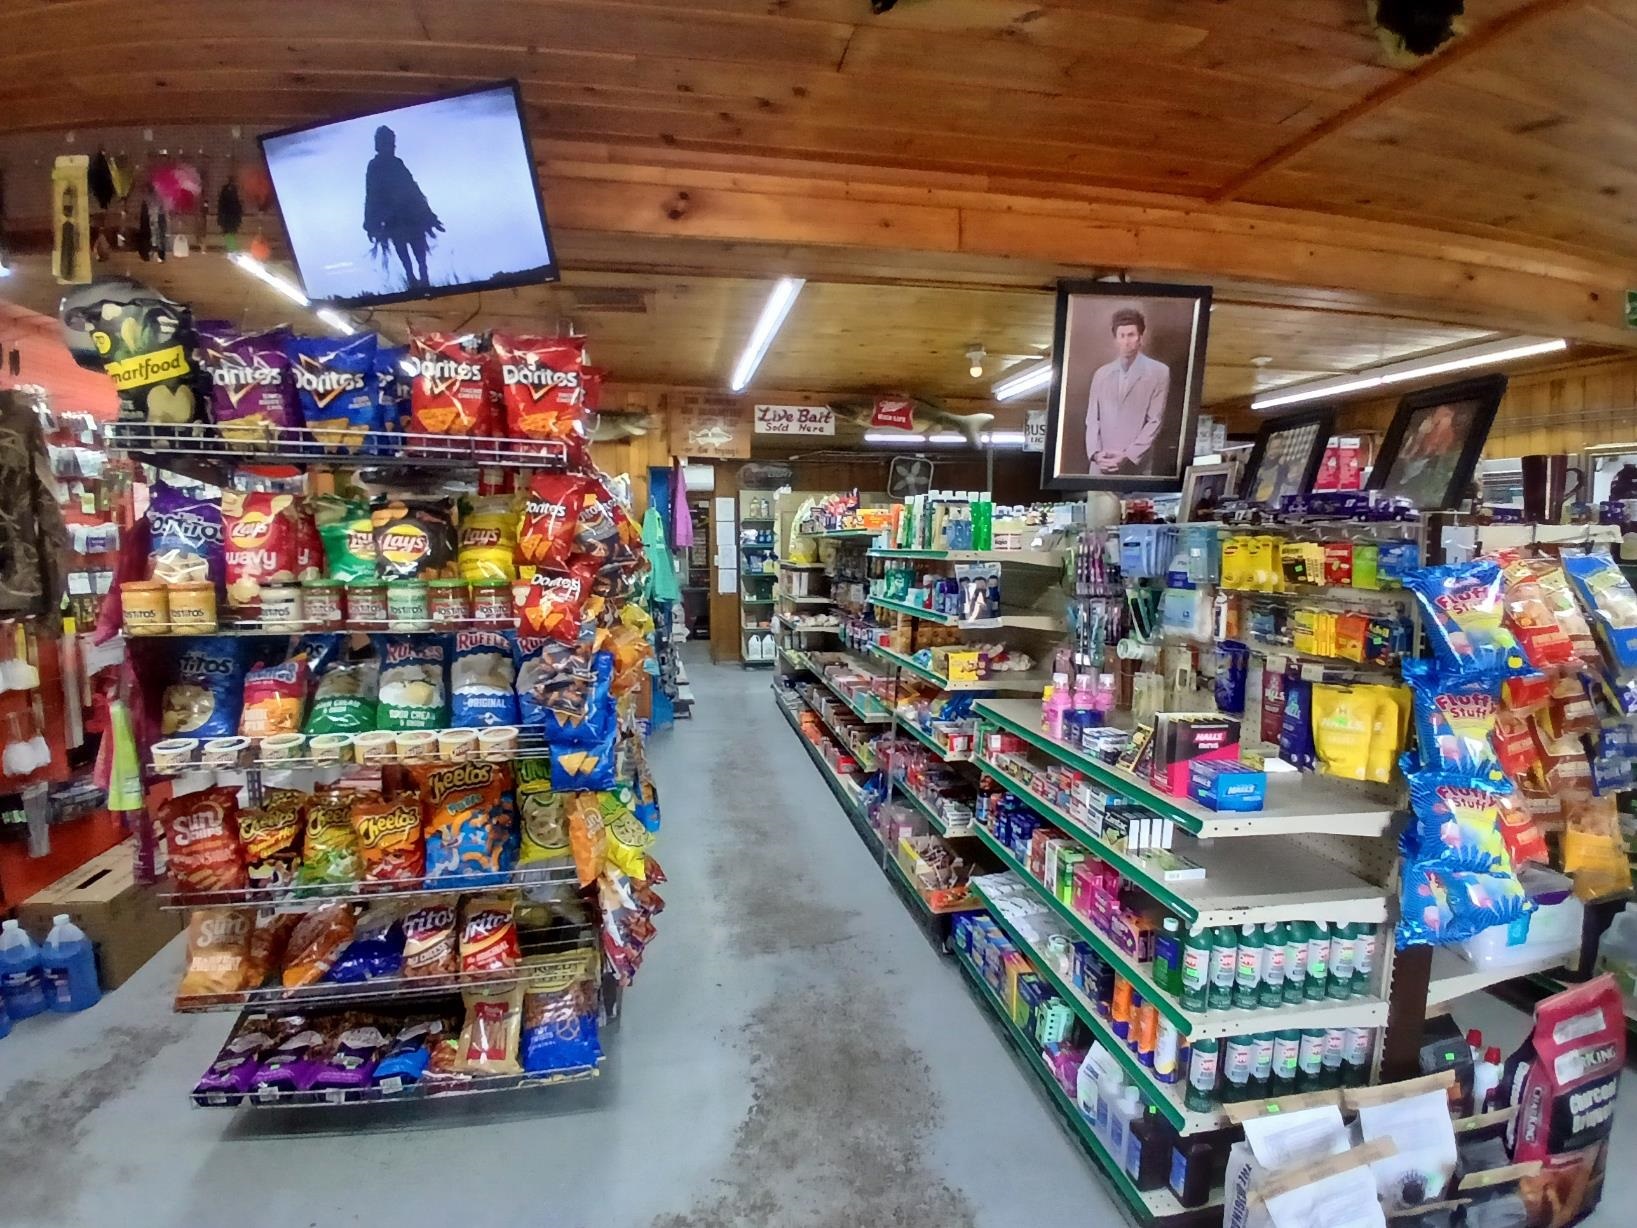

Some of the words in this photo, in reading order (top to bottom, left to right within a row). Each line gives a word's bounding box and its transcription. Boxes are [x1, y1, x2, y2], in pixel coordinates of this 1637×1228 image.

[104, 352, 182, 386] martfood
[209, 364, 281, 385] oritos
[413, 357, 482, 382] Doritos
[502, 364, 578, 387] Doritos
[758, 406, 794, 422] Live
[797, 408, 832, 423] Bait
[765, 422, 788, 432] Sold
[799, 424, 824, 433] Here
[1024, 424, 1047, 436] BUS
[383, 534, 425, 552] Lay's
[464, 529, 499, 546] Lay's
[226, 548, 277, 568] wavy
[467, 698, 506, 709] ORIGINAL
[1435, 692, 1497, 714] Fluffy
[1450, 707, 1486, 718] Stuff
[1455, 798, 1487, 811] Stuff
[308, 806, 351, 838] Cheet
[360, 808, 419, 847] Cheetos
